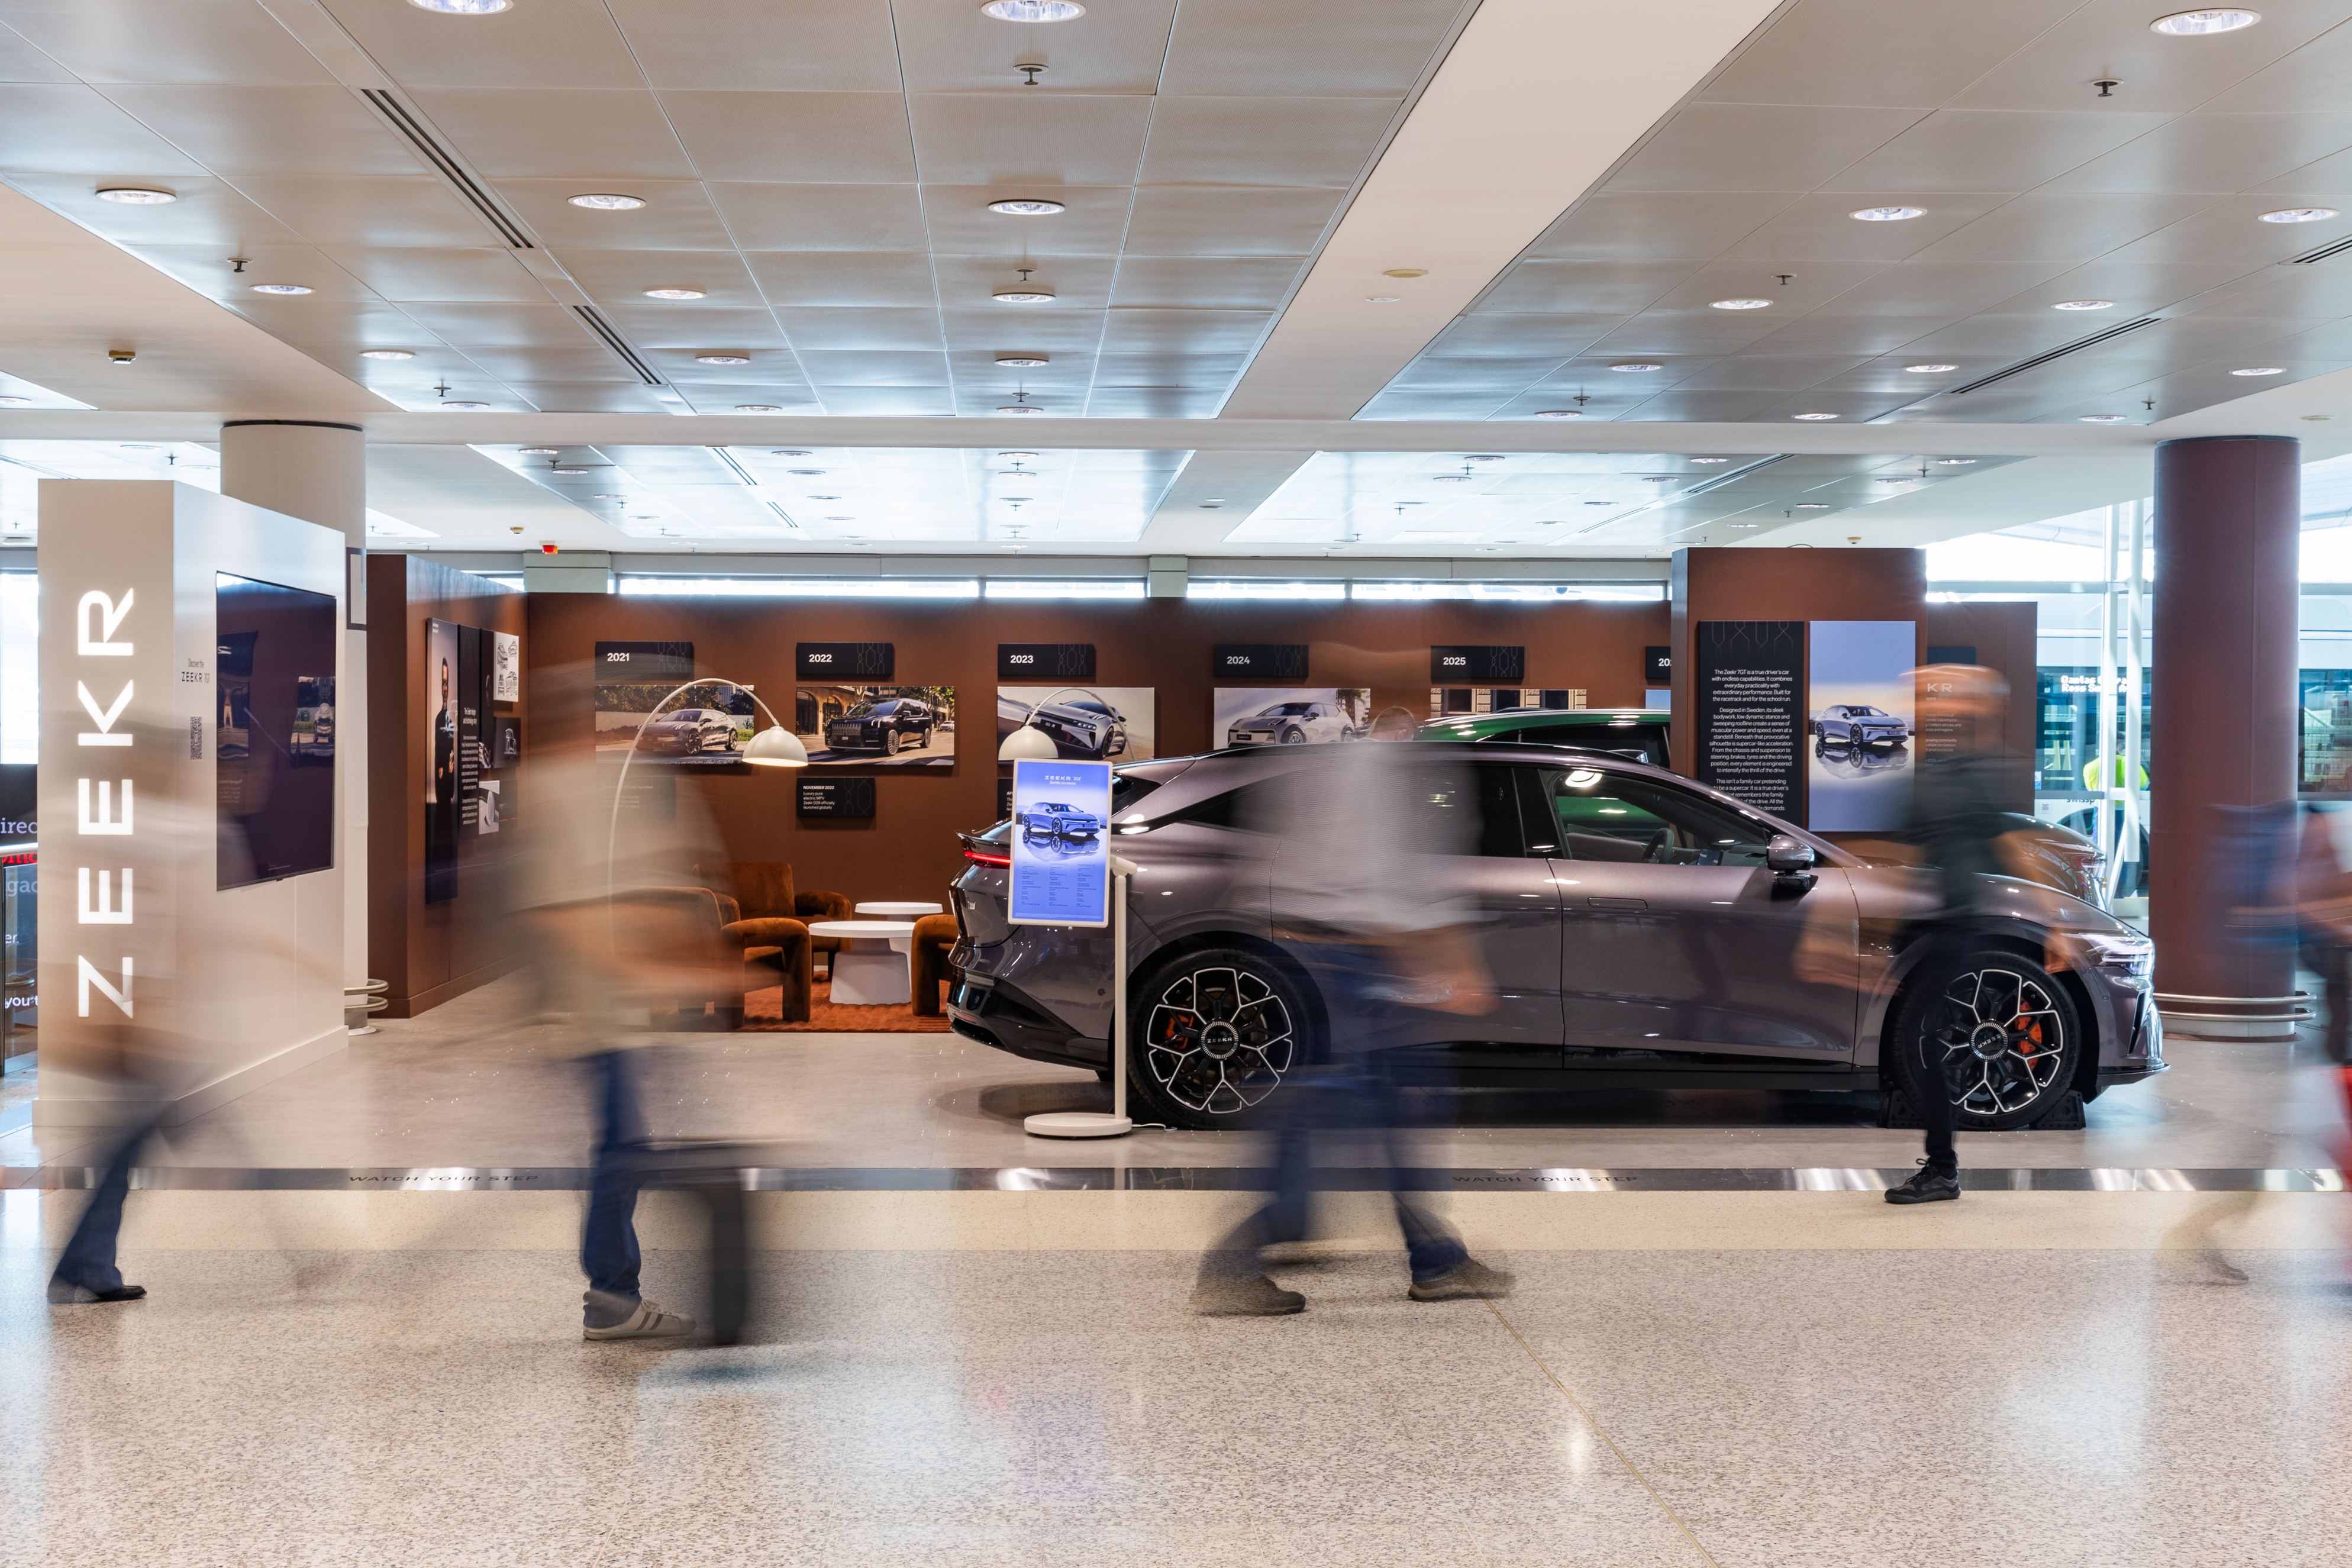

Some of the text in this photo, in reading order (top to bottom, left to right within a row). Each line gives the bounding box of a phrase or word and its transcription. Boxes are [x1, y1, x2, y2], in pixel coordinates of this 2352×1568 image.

[607, 653, 630, 662] 2021
[1011, 655, 1034, 663] 2023
[1443, 657, 1466, 665] 2025
[182, 672, 202, 683] ZEEKR
[2060, 676, 2096, 685] Qantas
[2061, 684, 2086, 692] Ross
[78, 588, 133, 1018] ZEEKR
[1977, 1034, 2001, 1048] ZEEKR
